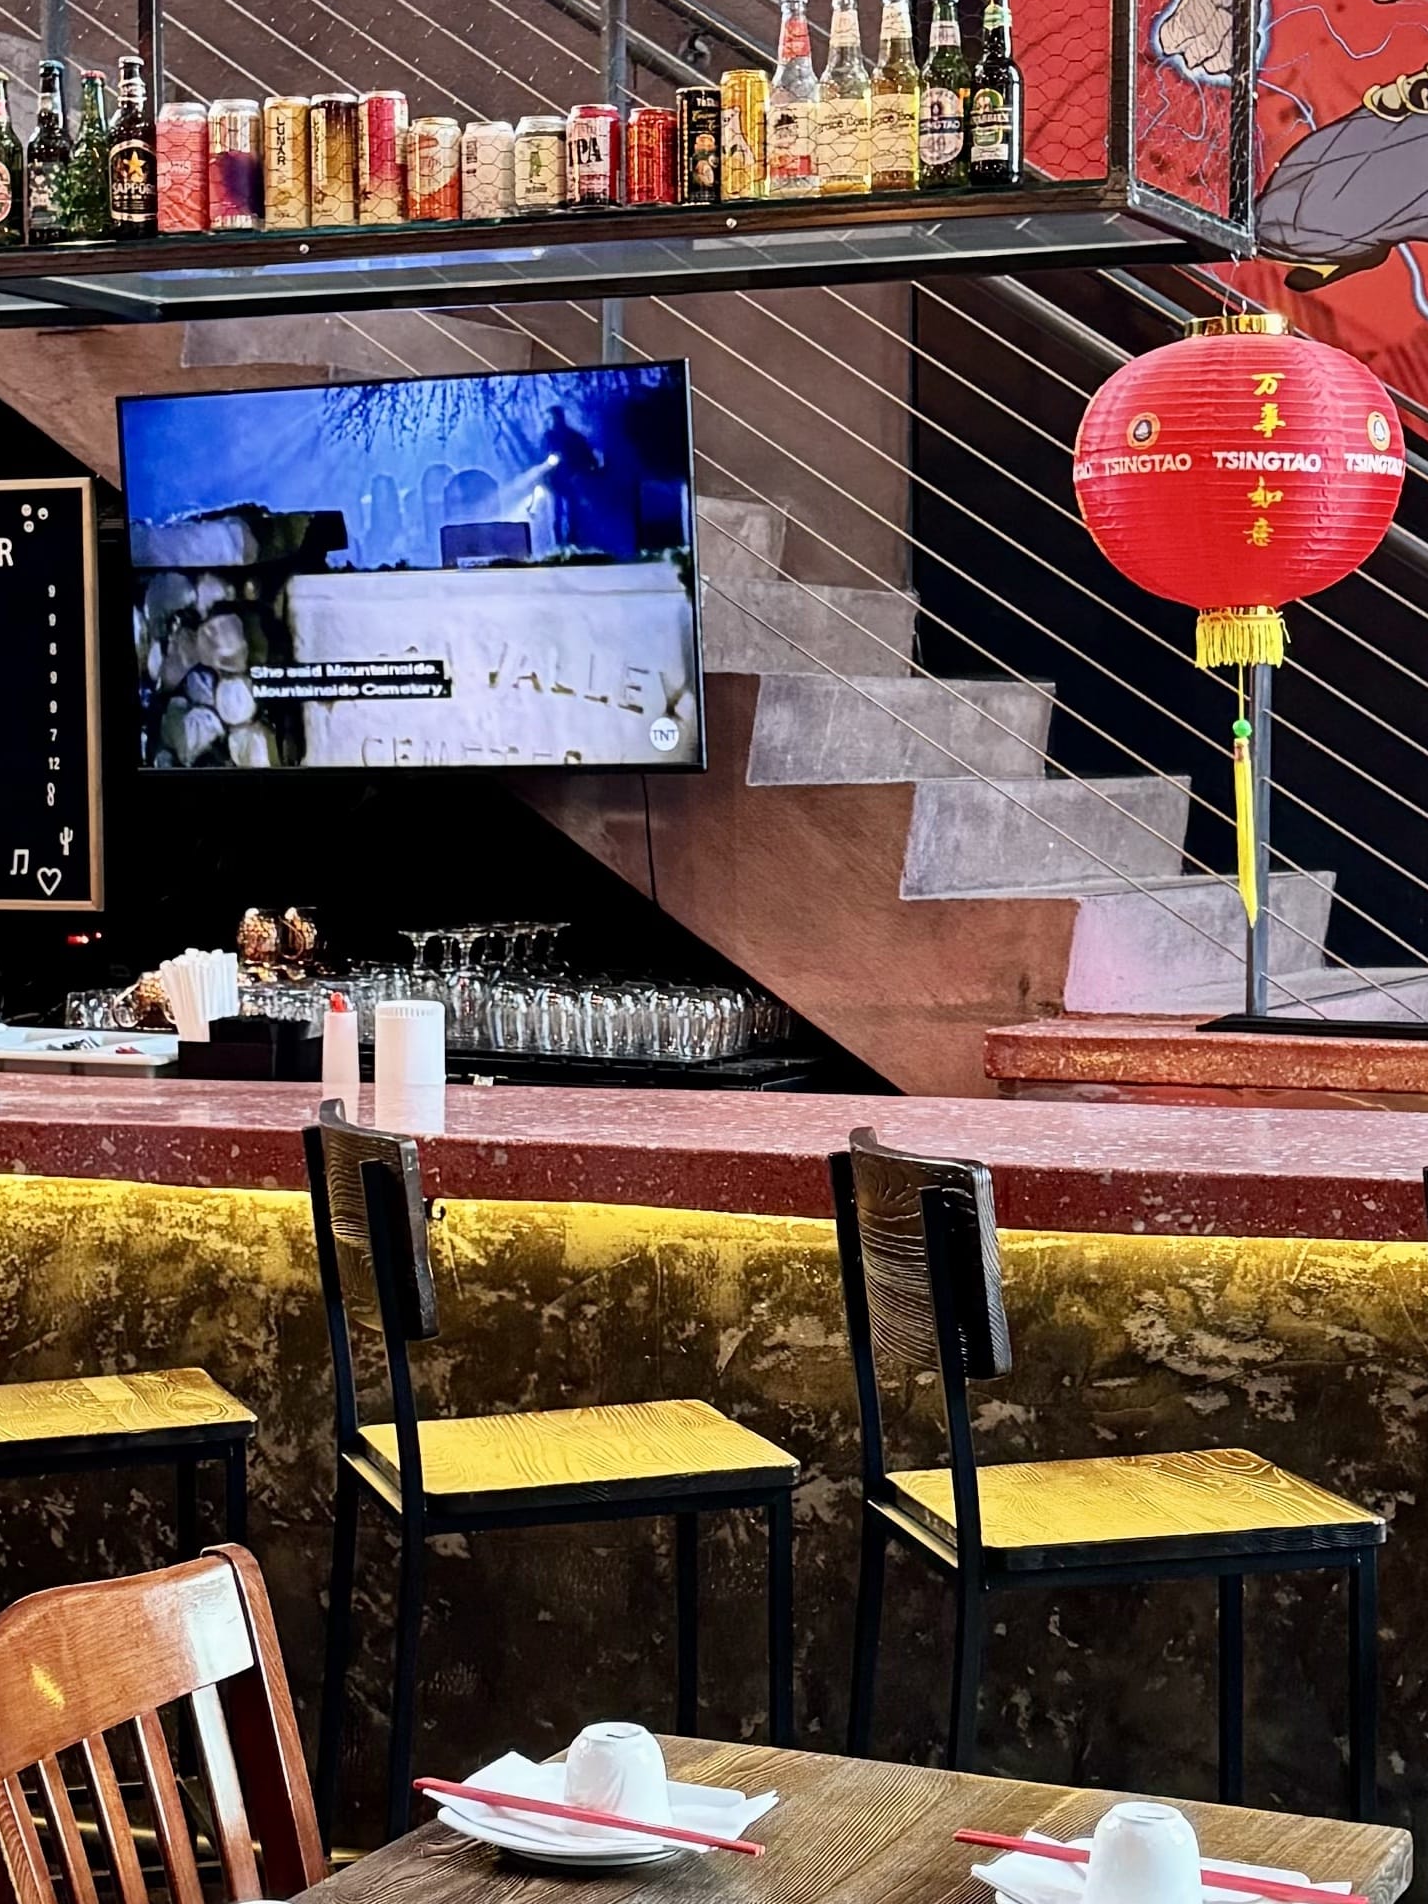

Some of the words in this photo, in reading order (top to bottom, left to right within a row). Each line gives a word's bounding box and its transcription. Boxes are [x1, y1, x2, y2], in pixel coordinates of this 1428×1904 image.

[276, 116, 286, 165] LUNAR
[1101, 453, 1192, 476] TSINGTAO
[1212, 451, 1321, 473] TSINGTAO
[1343, 453, 1403, 477] TSINGTA
[48, 584, 56, 598] 9
[49, 671, 58, 685] 9
[250, 665, 284, 679] She
[286, 664, 322, 678] said
[49, 728, 58, 742] 7
[651, 728, 679, 742] TNT
[48, 756, 61, 771] 12
